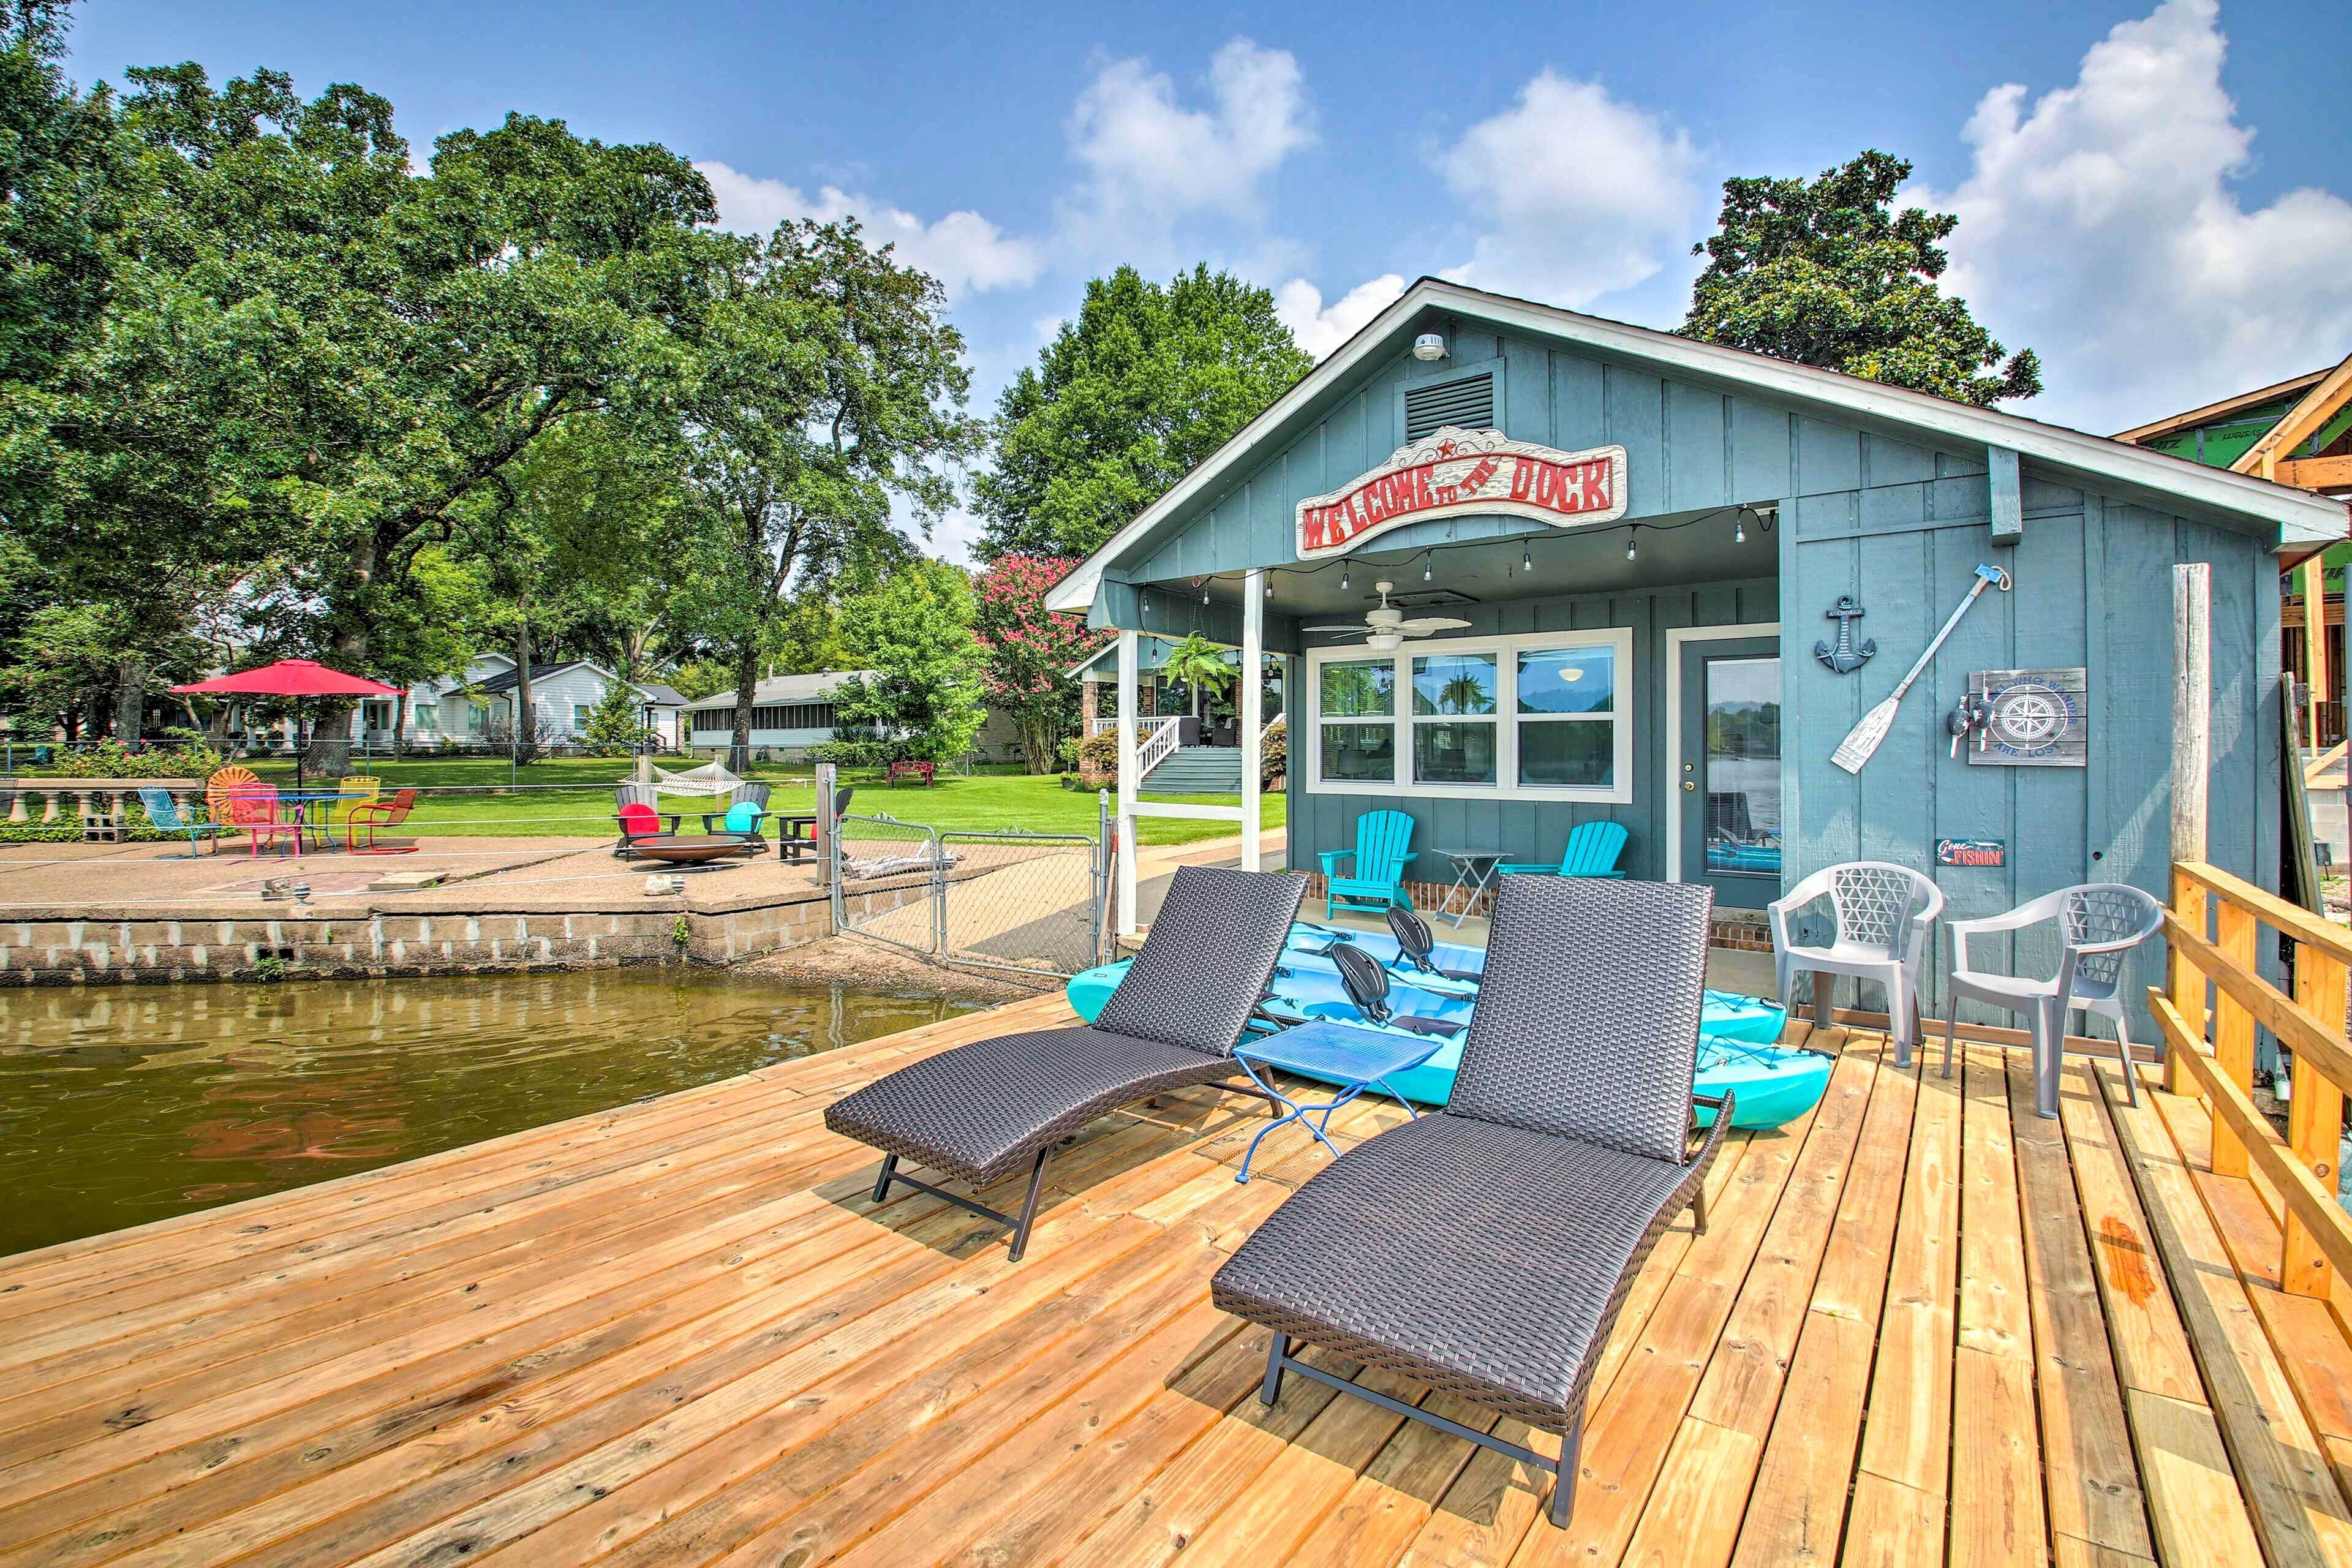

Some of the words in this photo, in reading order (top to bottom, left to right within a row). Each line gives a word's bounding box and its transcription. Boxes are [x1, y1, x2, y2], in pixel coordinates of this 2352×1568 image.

[1306, 464, 1434, 546] WELCOME
[1436, 484, 1458, 505] TO
[1460, 458, 1498, 495] THE
[1509, 457, 1608, 510] DOCK
[2011, 677, 2043, 685] WHO
[2049, 681, 2077, 724] WANDER
[1994, 742, 2019, 756] ARE
[2028, 743, 2059, 757] LOST
[1937, 839, 1973, 856] Gone
[1954, 850, 2004, 865] FISHIN'
